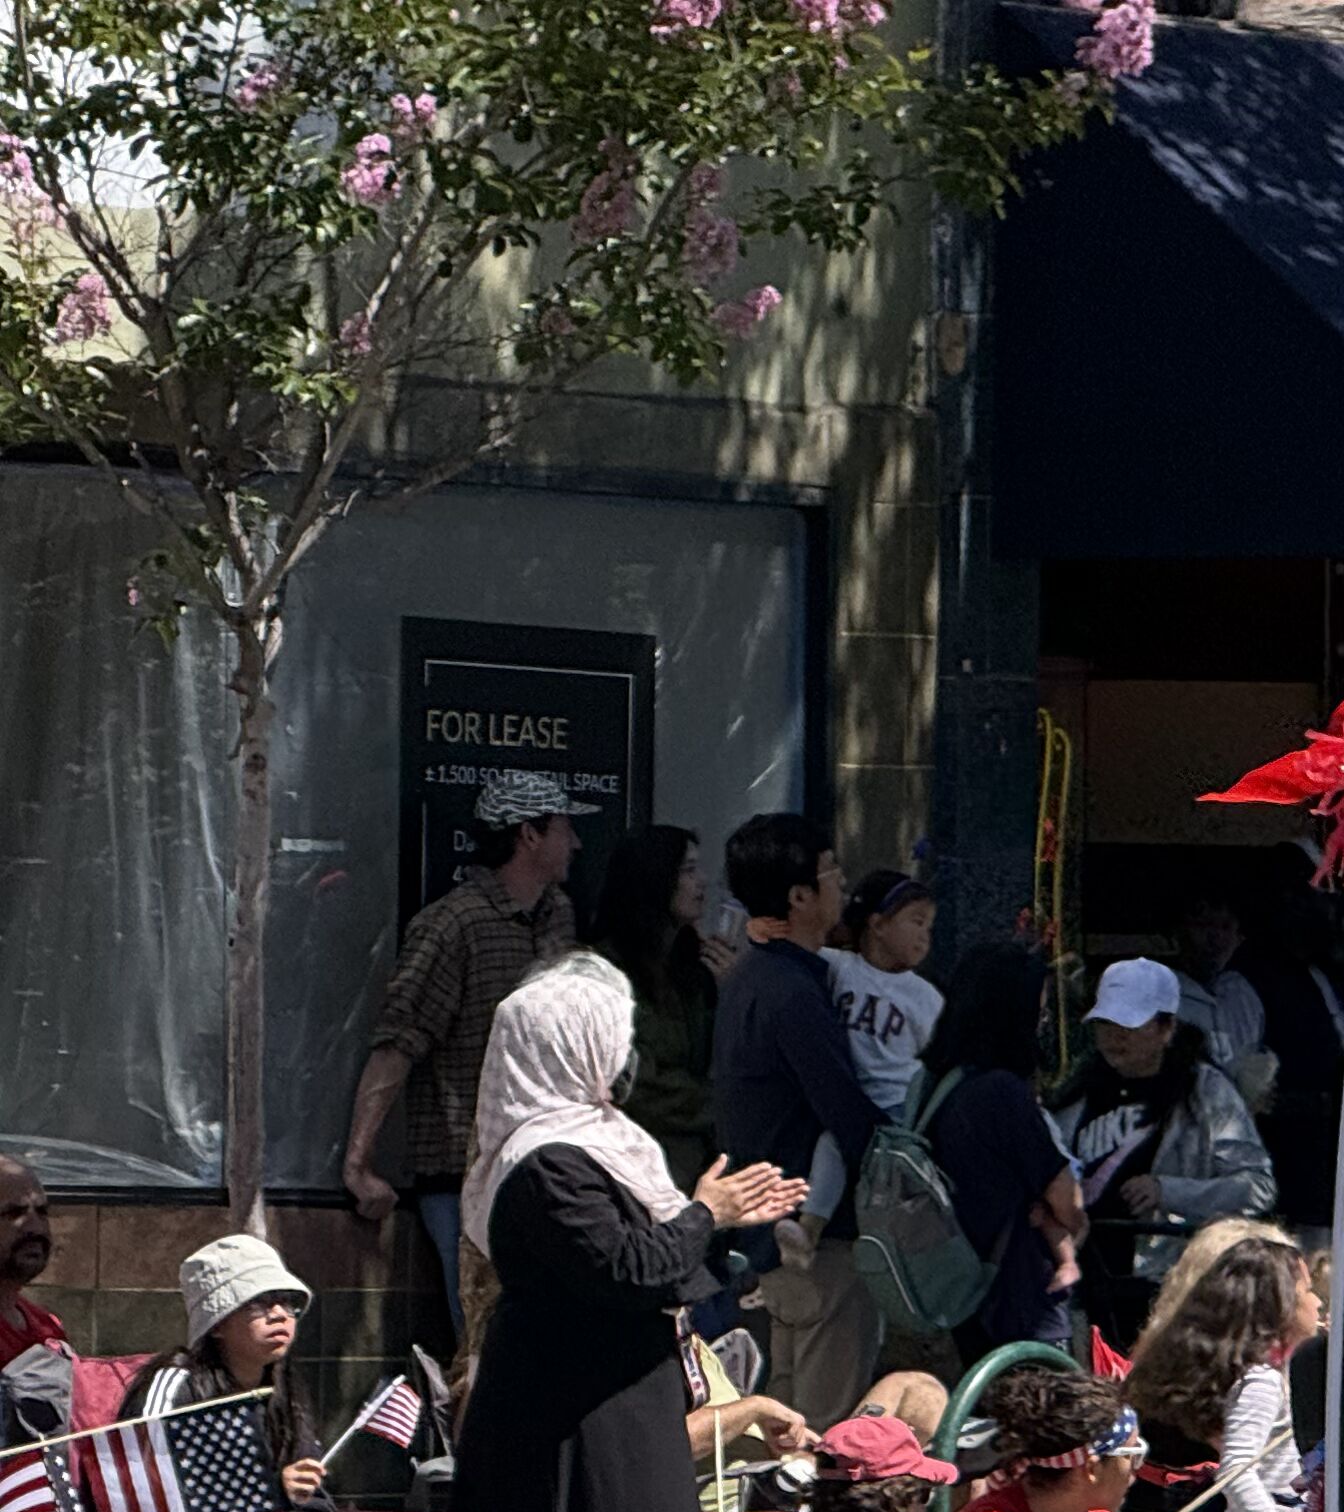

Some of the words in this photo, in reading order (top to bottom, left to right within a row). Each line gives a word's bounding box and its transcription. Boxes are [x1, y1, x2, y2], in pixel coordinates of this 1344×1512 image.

[426, 709, 481, 745] FOR
[489, 713, 570, 750] LEASE
[573, 773, 620, 793] SPACE
[838, 990, 906, 1046] GAP
[1077, 1102, 1150, 1163] NIKE
